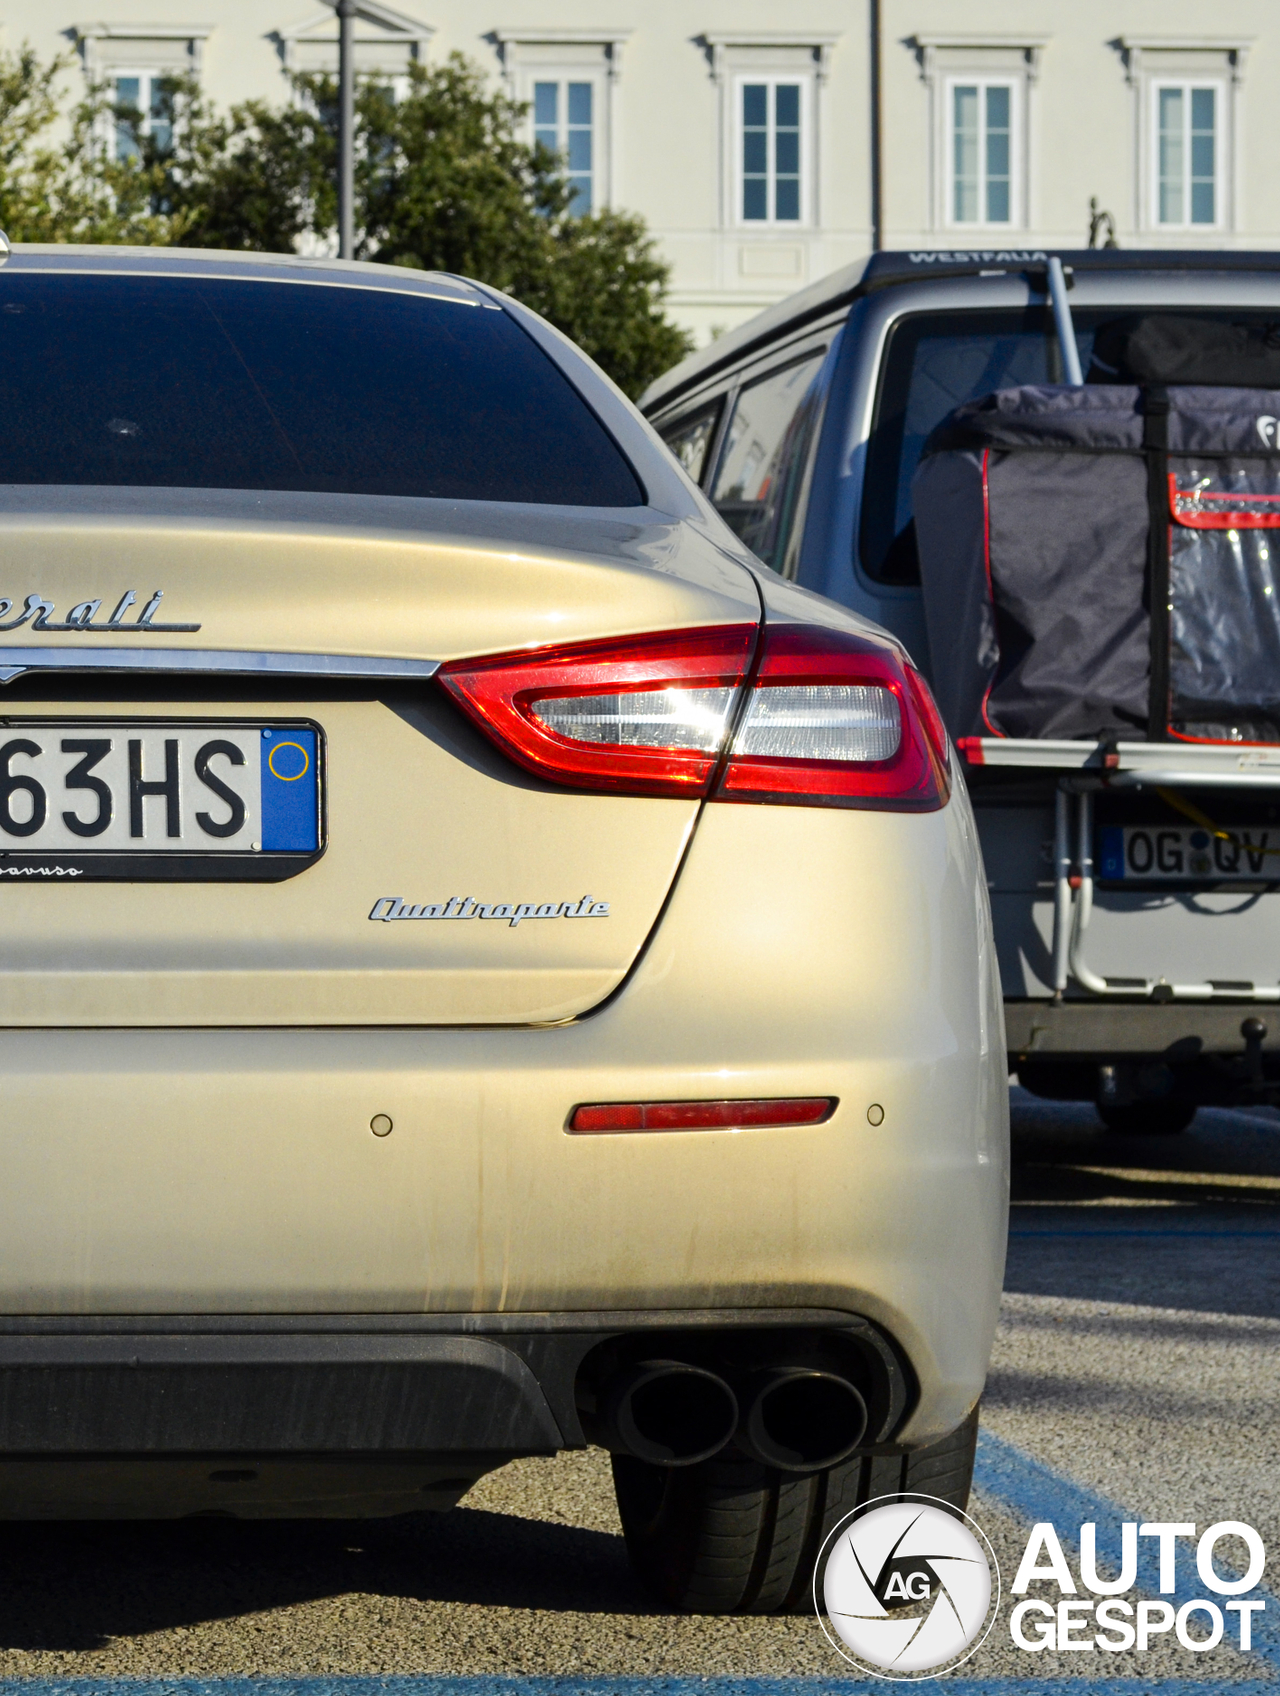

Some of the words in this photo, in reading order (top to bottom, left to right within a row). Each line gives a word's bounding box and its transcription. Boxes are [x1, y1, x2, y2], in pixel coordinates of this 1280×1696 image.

[908, 251, 1047, 263] WESTFALIA
[1127, 830, 1184, 873] OG
[368, 895, 611, 927] Quattroporte
